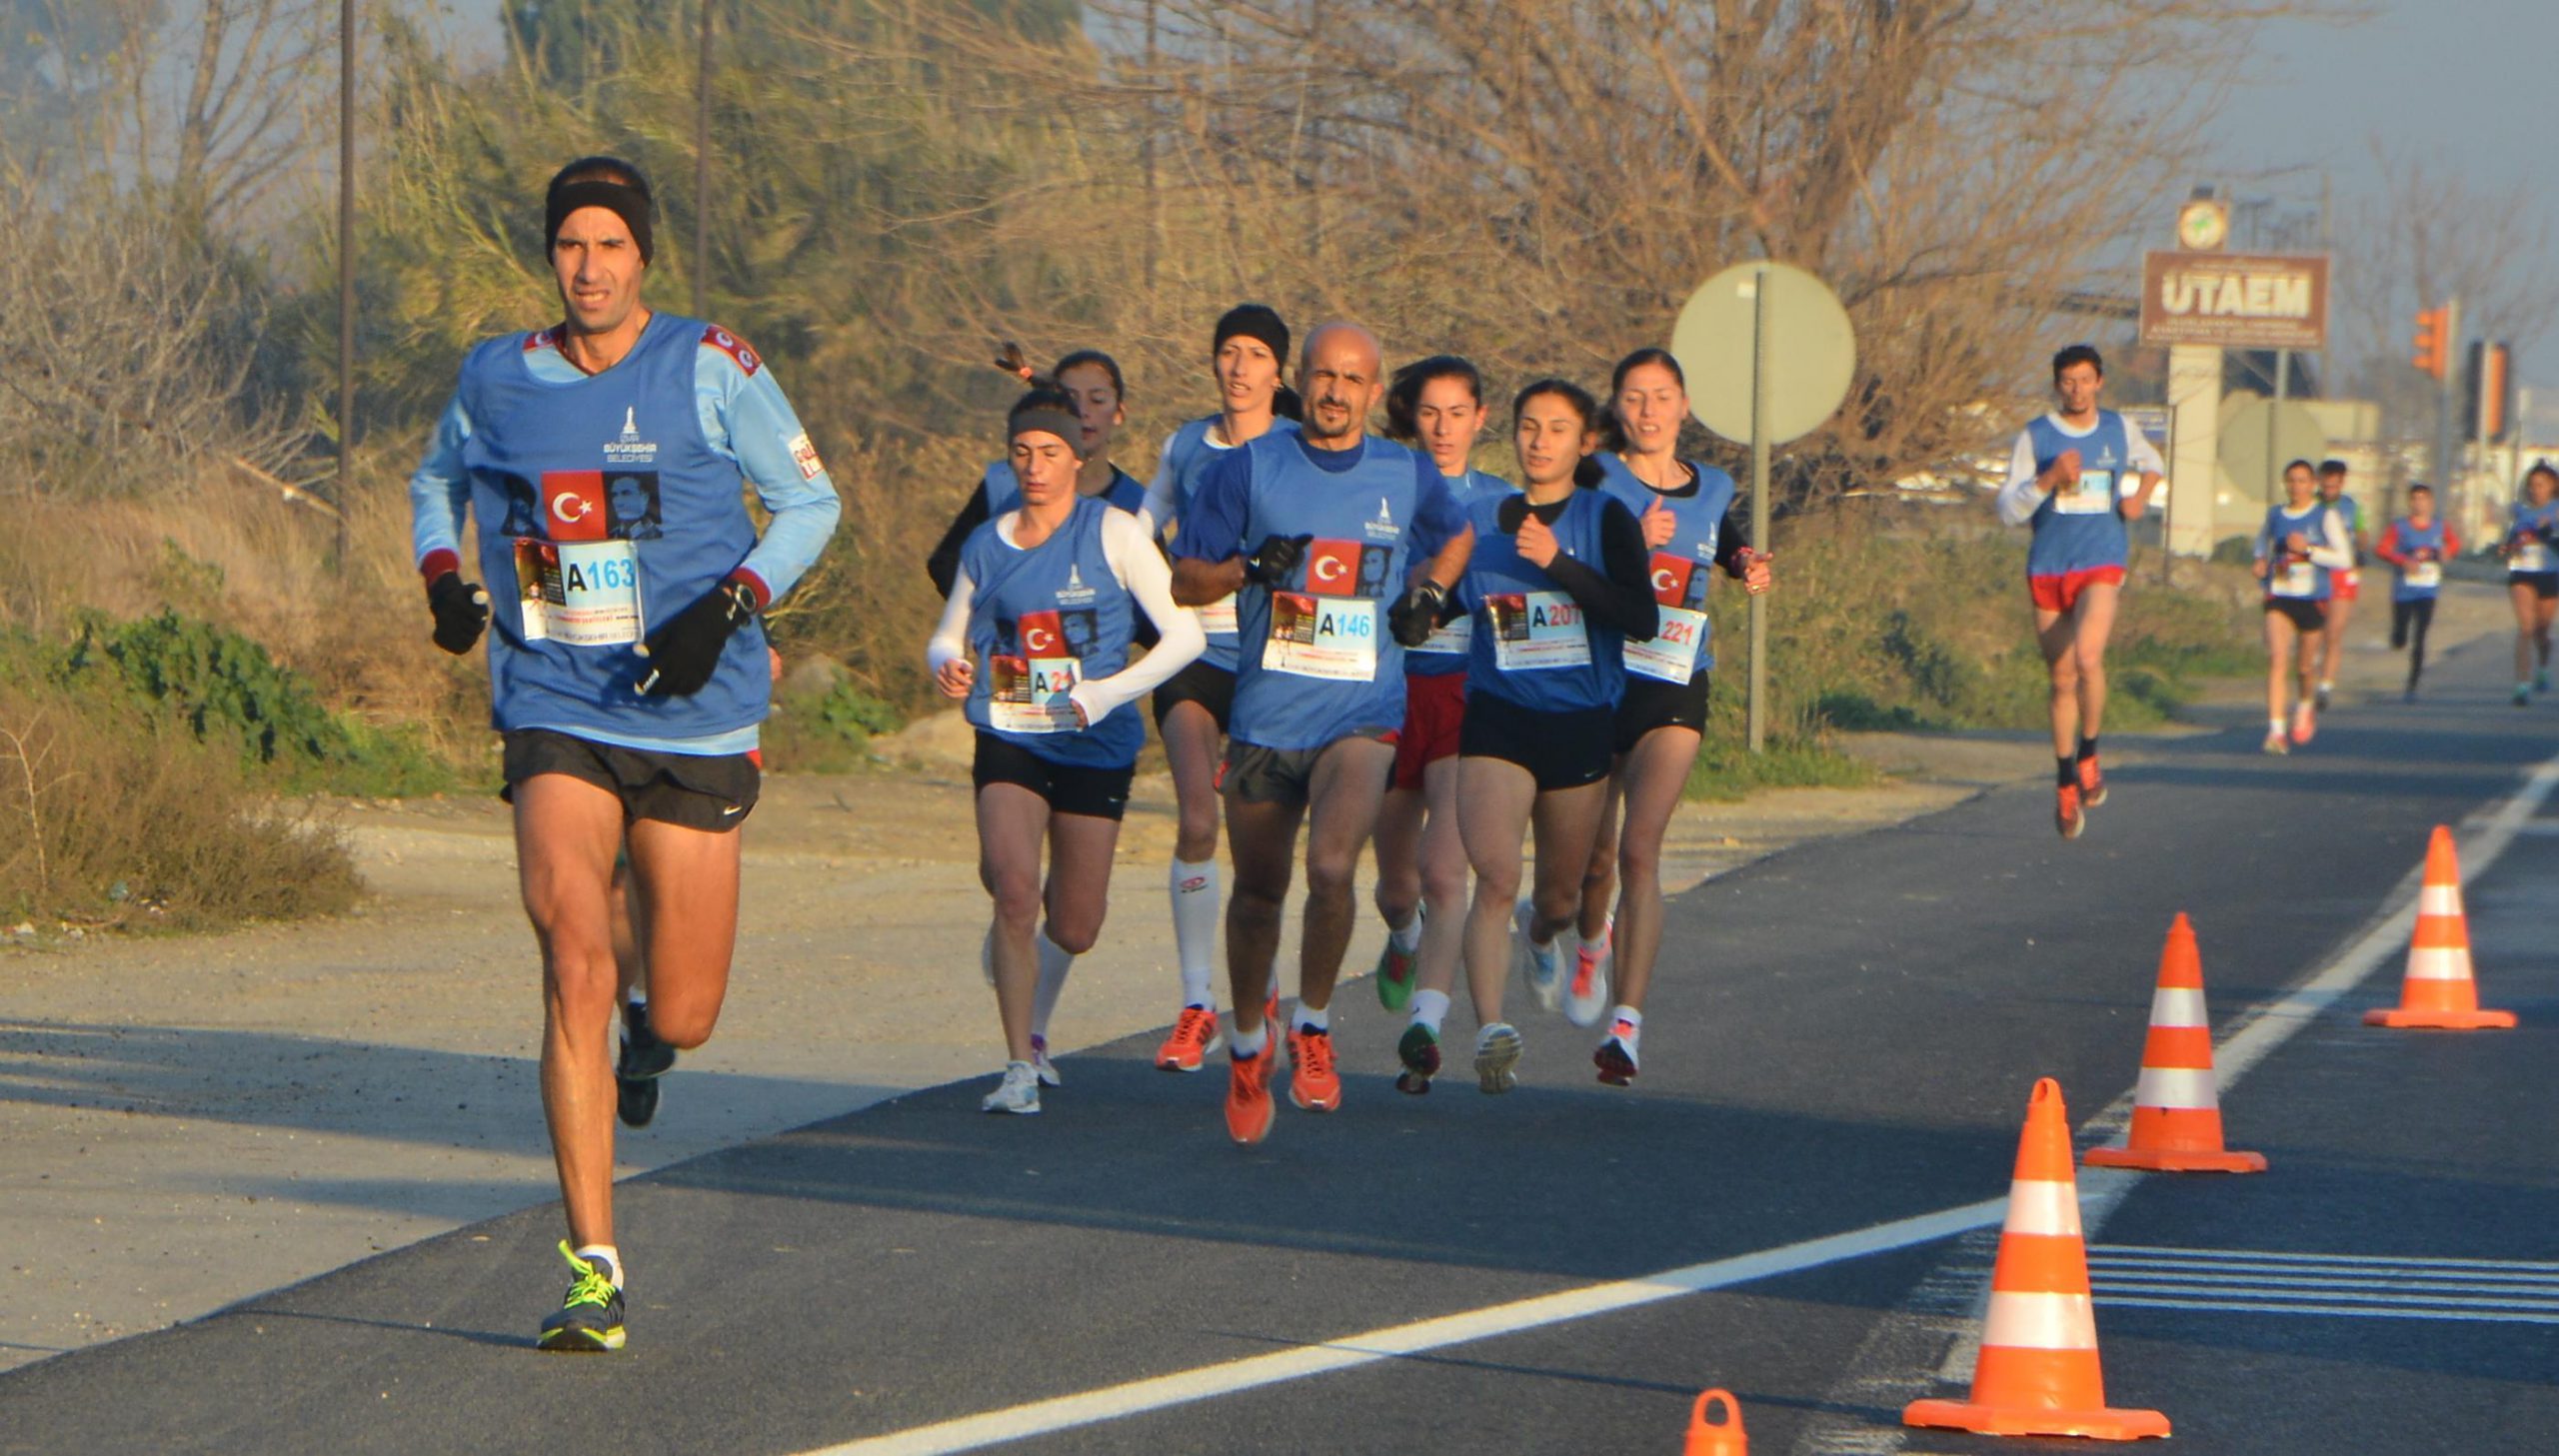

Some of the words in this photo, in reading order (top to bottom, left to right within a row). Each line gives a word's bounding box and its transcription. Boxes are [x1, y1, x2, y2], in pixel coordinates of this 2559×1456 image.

[2162, 272, 2311, 319] UTAEM
[567, 559, 637, 593] A163
[1318, 613, 1370, 638] A146
